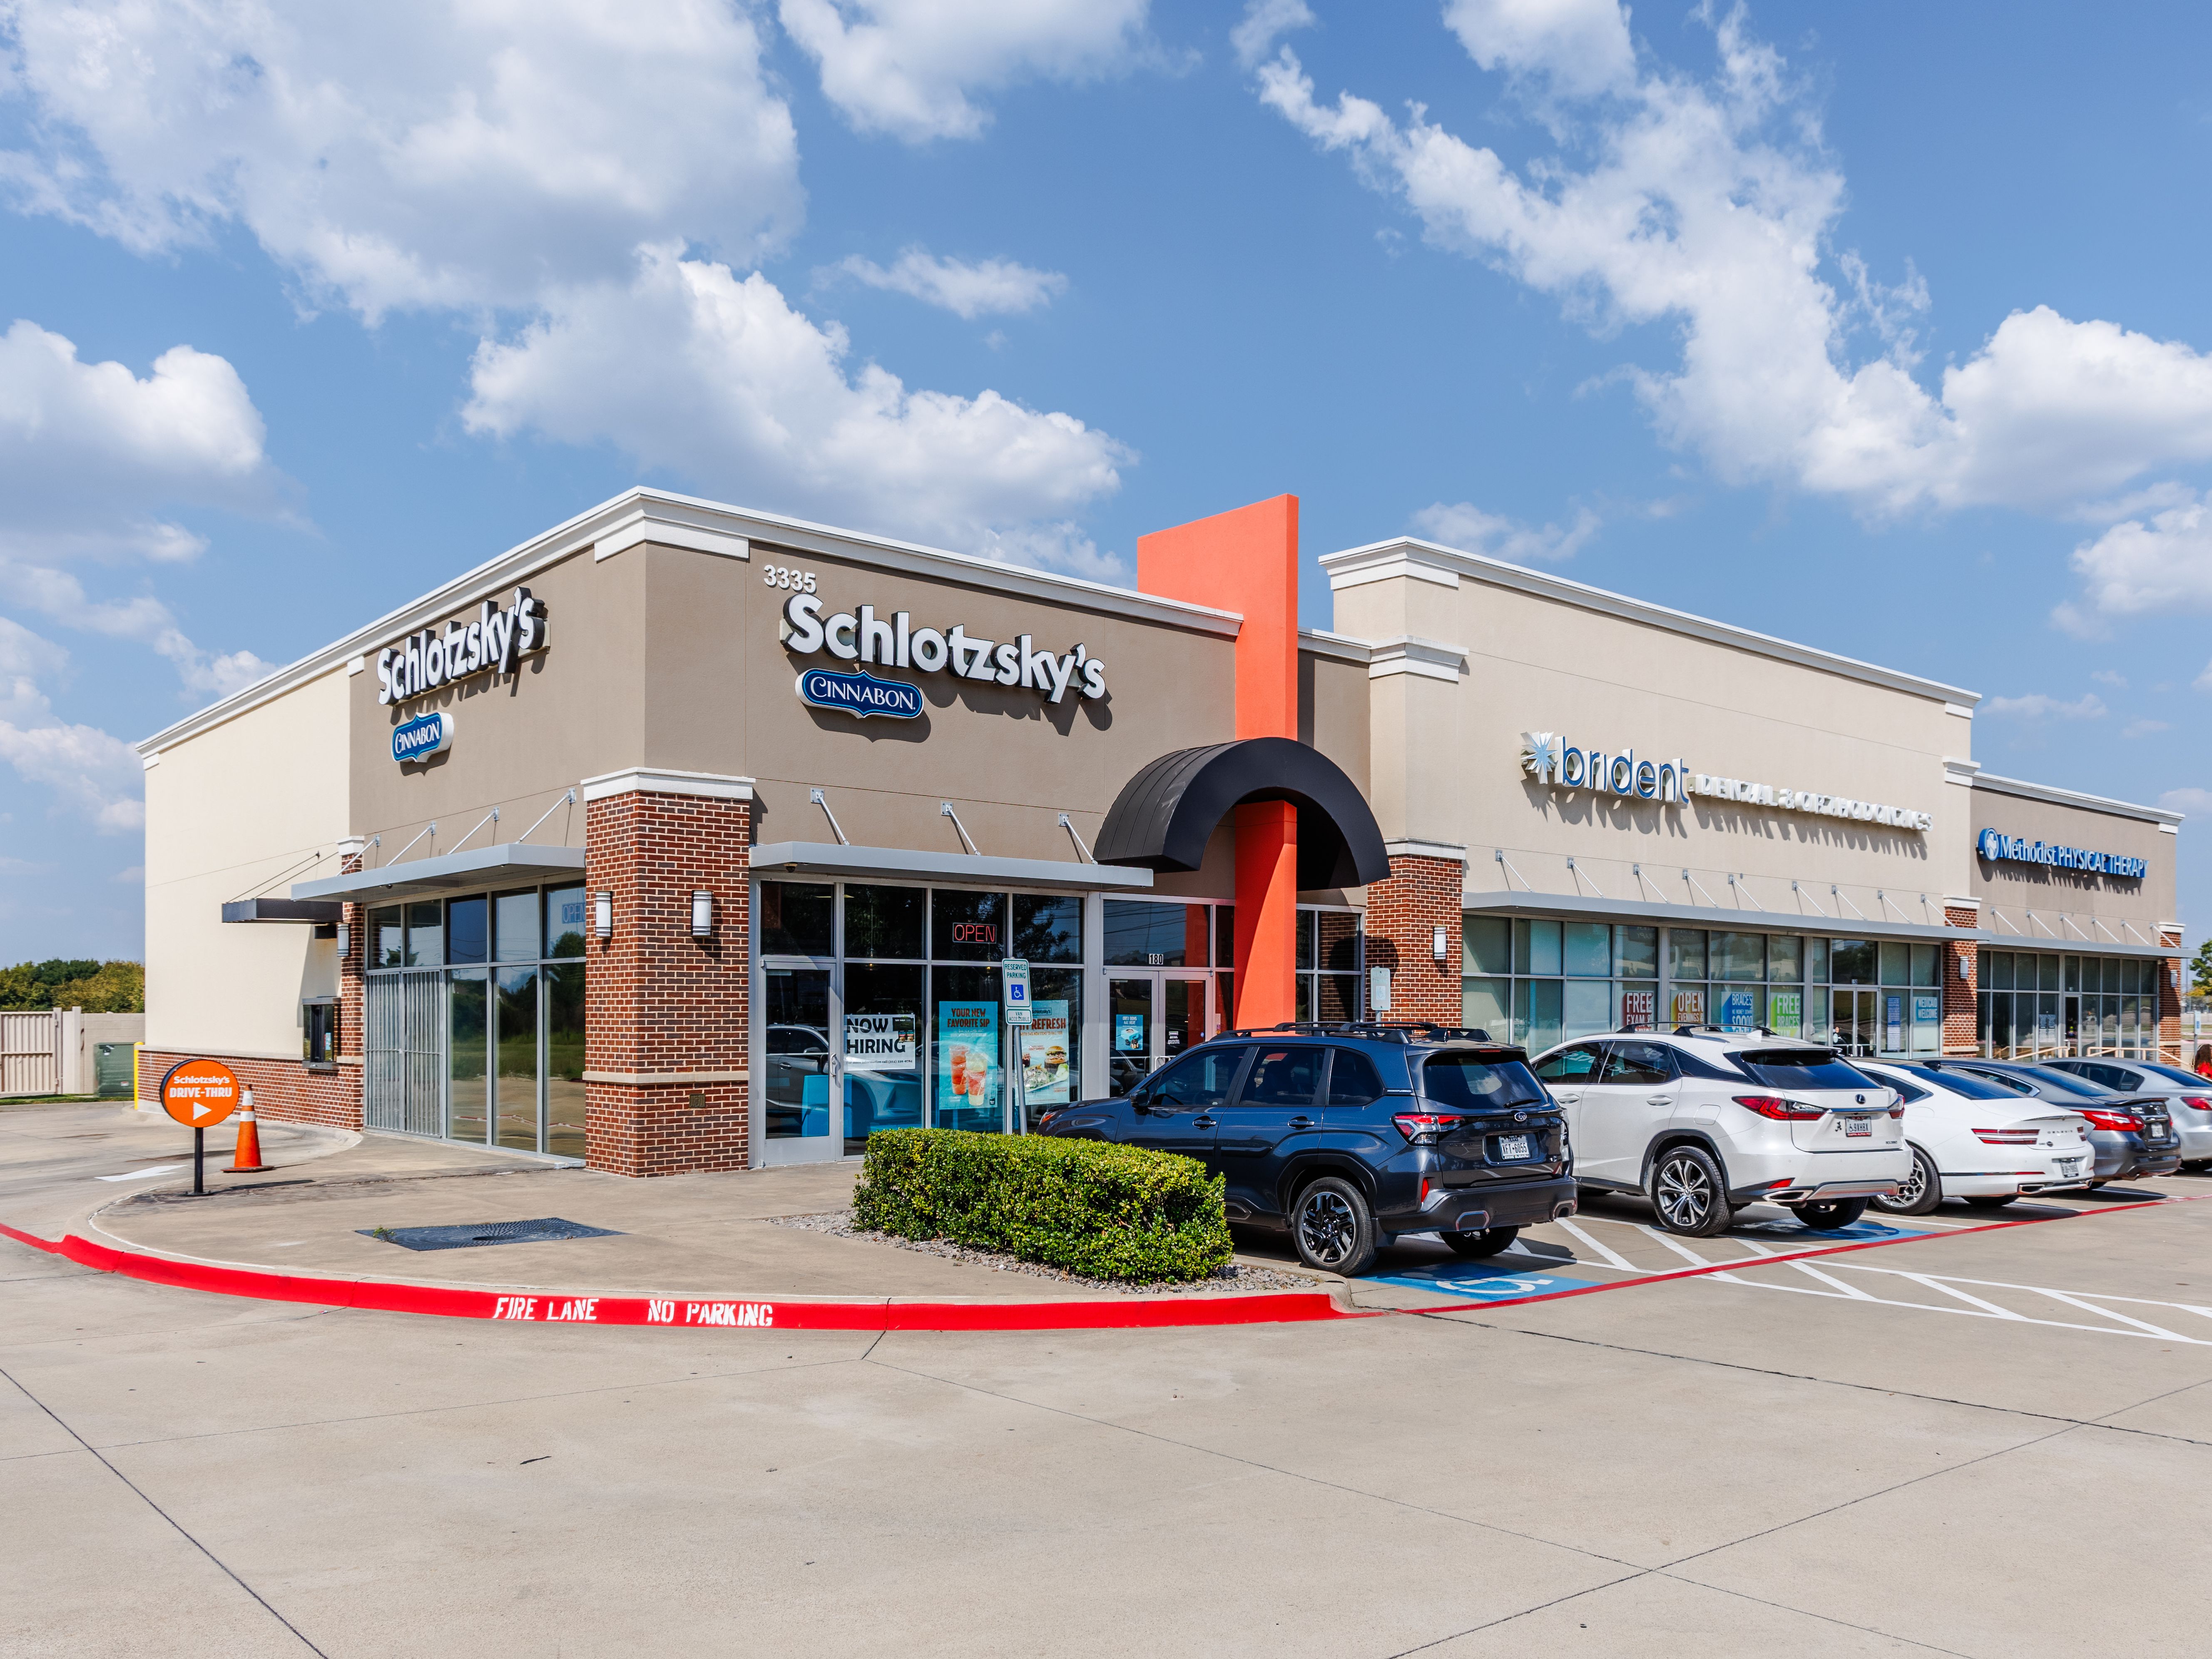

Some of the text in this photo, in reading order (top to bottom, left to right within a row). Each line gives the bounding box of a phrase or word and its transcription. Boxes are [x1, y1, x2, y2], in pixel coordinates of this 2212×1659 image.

[764, 565, 816, 593] 3335
[377, 586, 535, 705] Schlotzsky's
[785, 593, 1105, 704] Schlotzsky's
[1556, 736, 1689, 805] brident
[1694, 774, 1934, 832] DENTAL & ORTHODONTICS
[2000, 835, 2150, 878] Methodist PHYSICAL THERAPY
[955, 924, 995, 942] OPEN
[1150, 954, 1162, 964] 180
[1627, 992, 1652, 1013] FREE
[1678, 992, 1704, 1012] OPEN
[1732, 993, 1753, 1006] BRACES
[1777, 995, 1800, 1014] FREE
[1918, 998, 1937, 1007] MEDICAID
[951, 1008, 986, 1017] YOUR NEW
[1678, 1013, 1699, 1022] EVENINGS
[1918, 1009, 1937, 1018] WELCOME
[846, 1018, 888, 1033] NOW
[947, 1018, 990, 1027] FAVORITE SIP
[1031, 1018, 1066, 1030] REFRESH
[1777, 1015, 1799, 1028] BRACES
[846, 1039, 906, 1054] HIRING
[173, 1076, 230, 1085] Schlotzsky's
[169, 1087, 232, 1098] DRIVE-THRU
[493, 1297, 773, 1327] FIRE LANE NO PARKING
